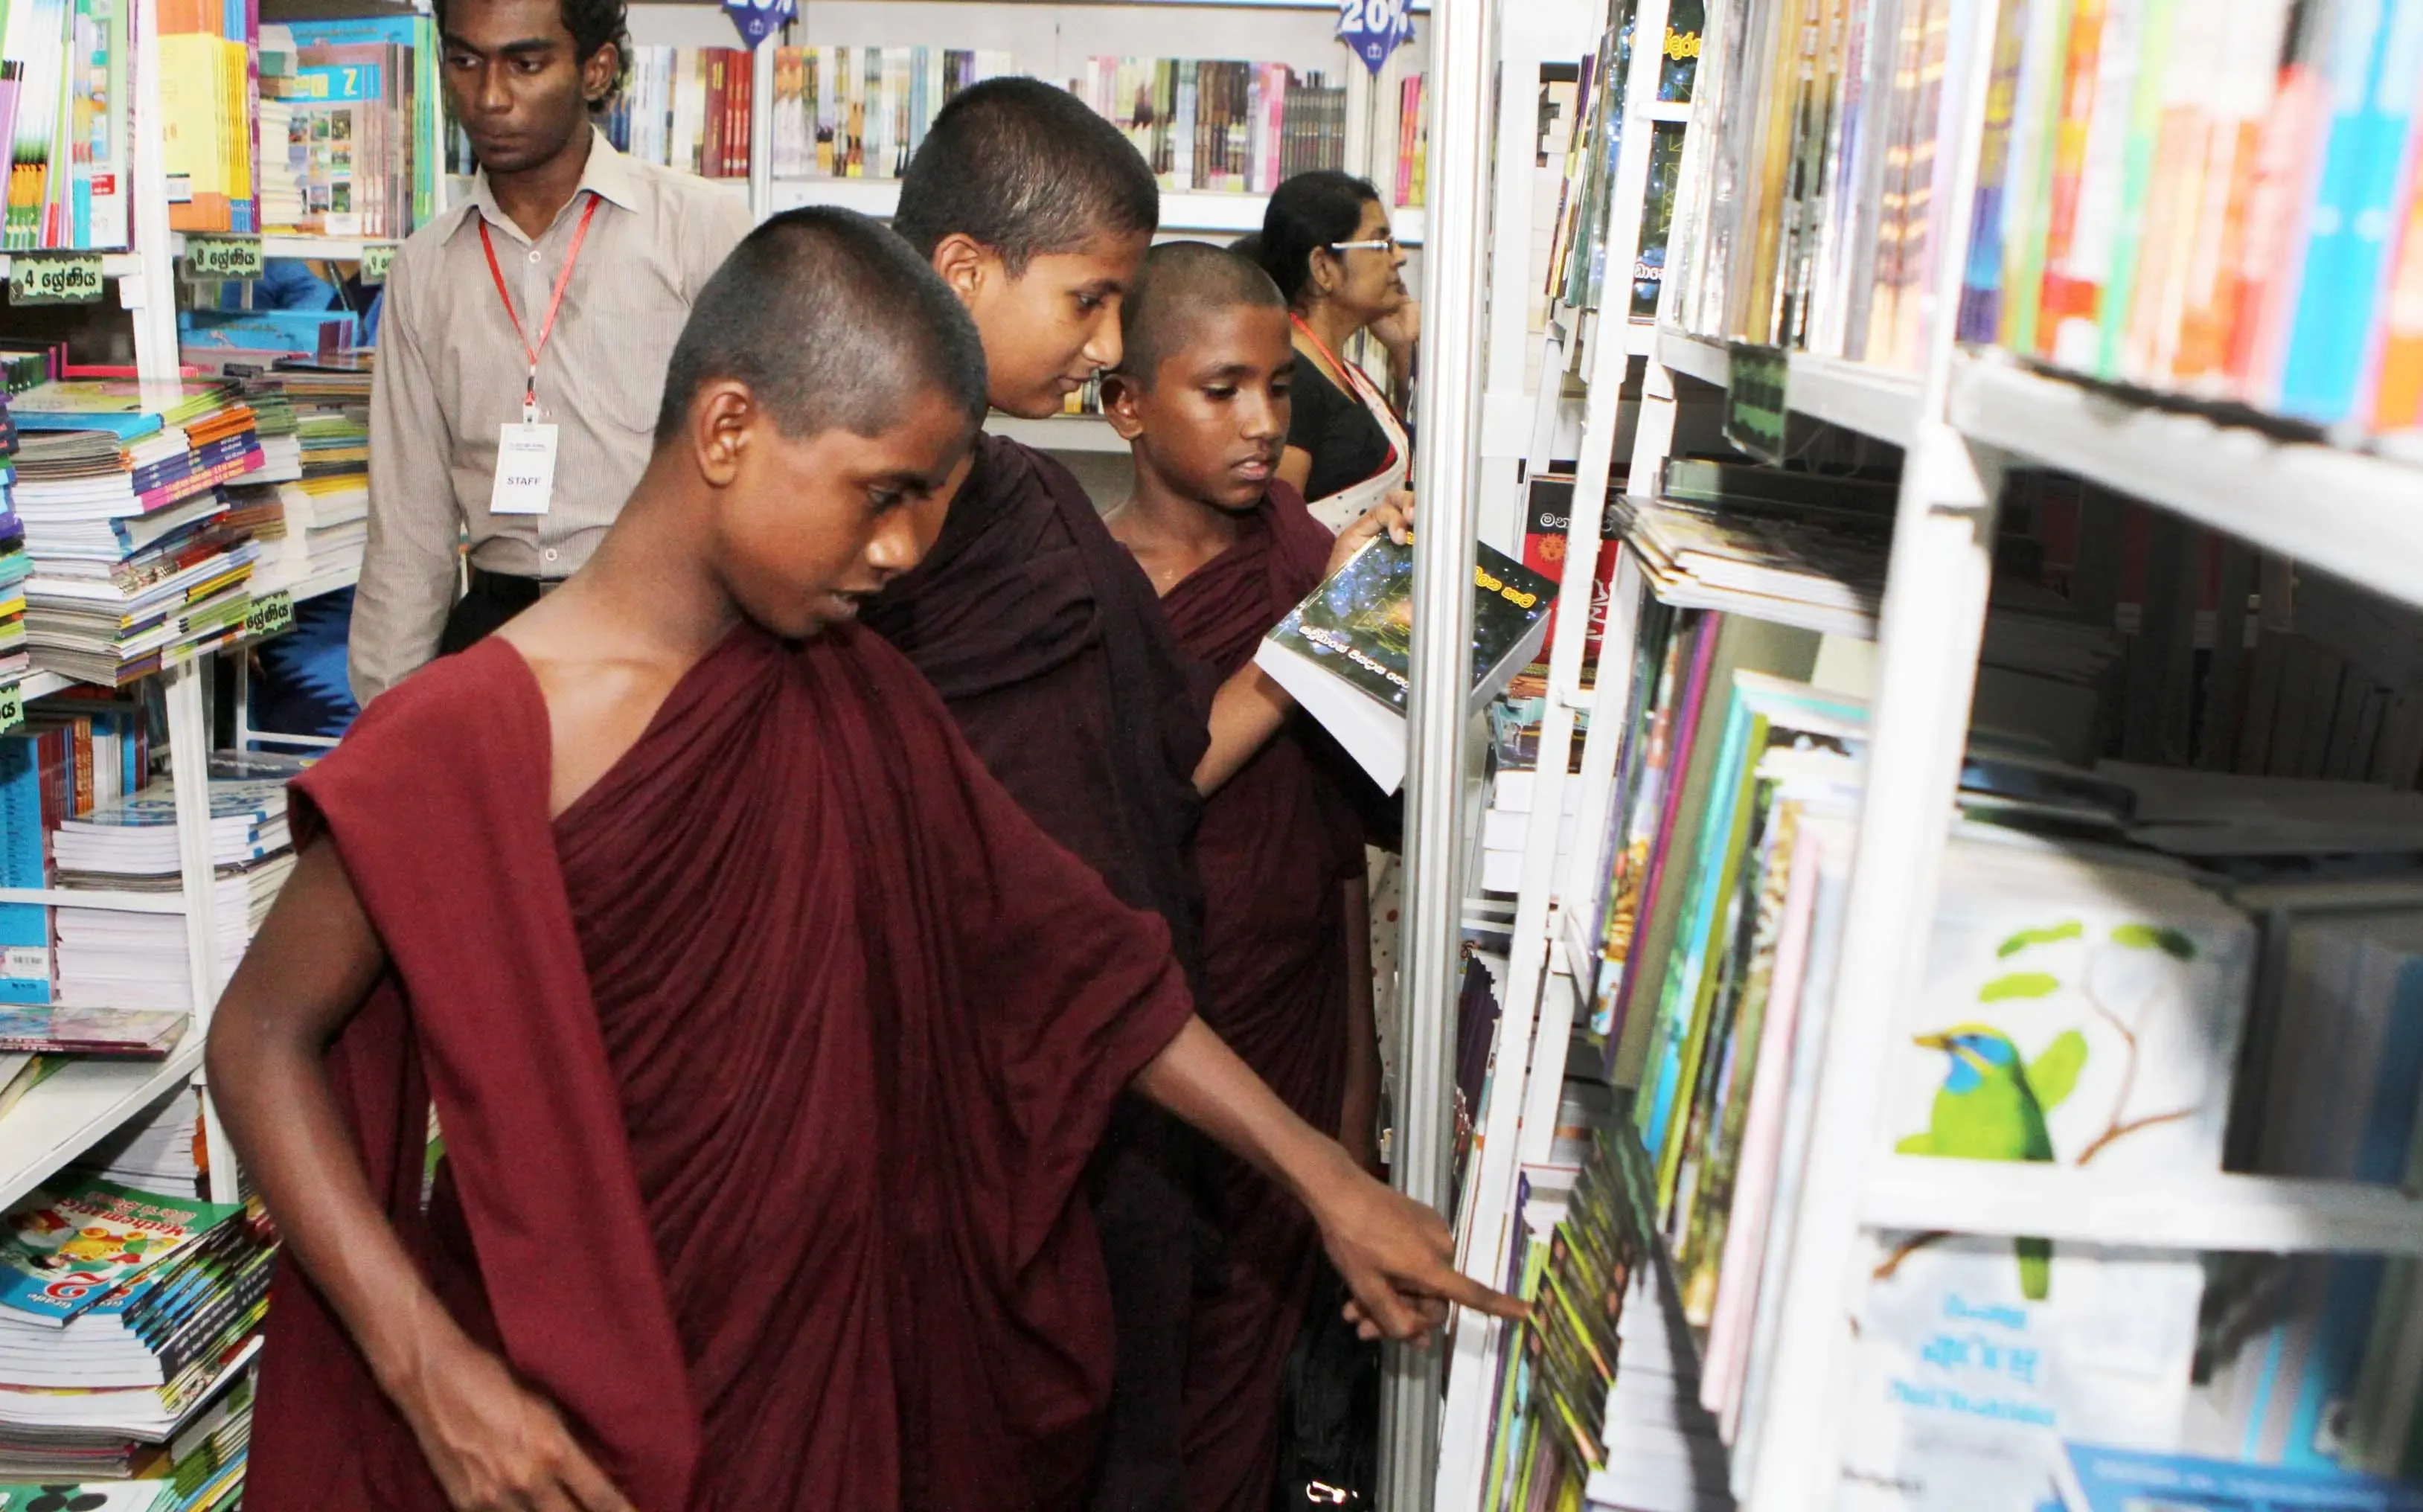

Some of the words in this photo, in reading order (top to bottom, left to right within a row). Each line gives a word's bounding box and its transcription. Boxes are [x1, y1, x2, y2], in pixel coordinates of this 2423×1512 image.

[196, 249, 204, 266] 8
[25, 269, 34, 288] 4
[507, 476, 542, 486] STAFF
